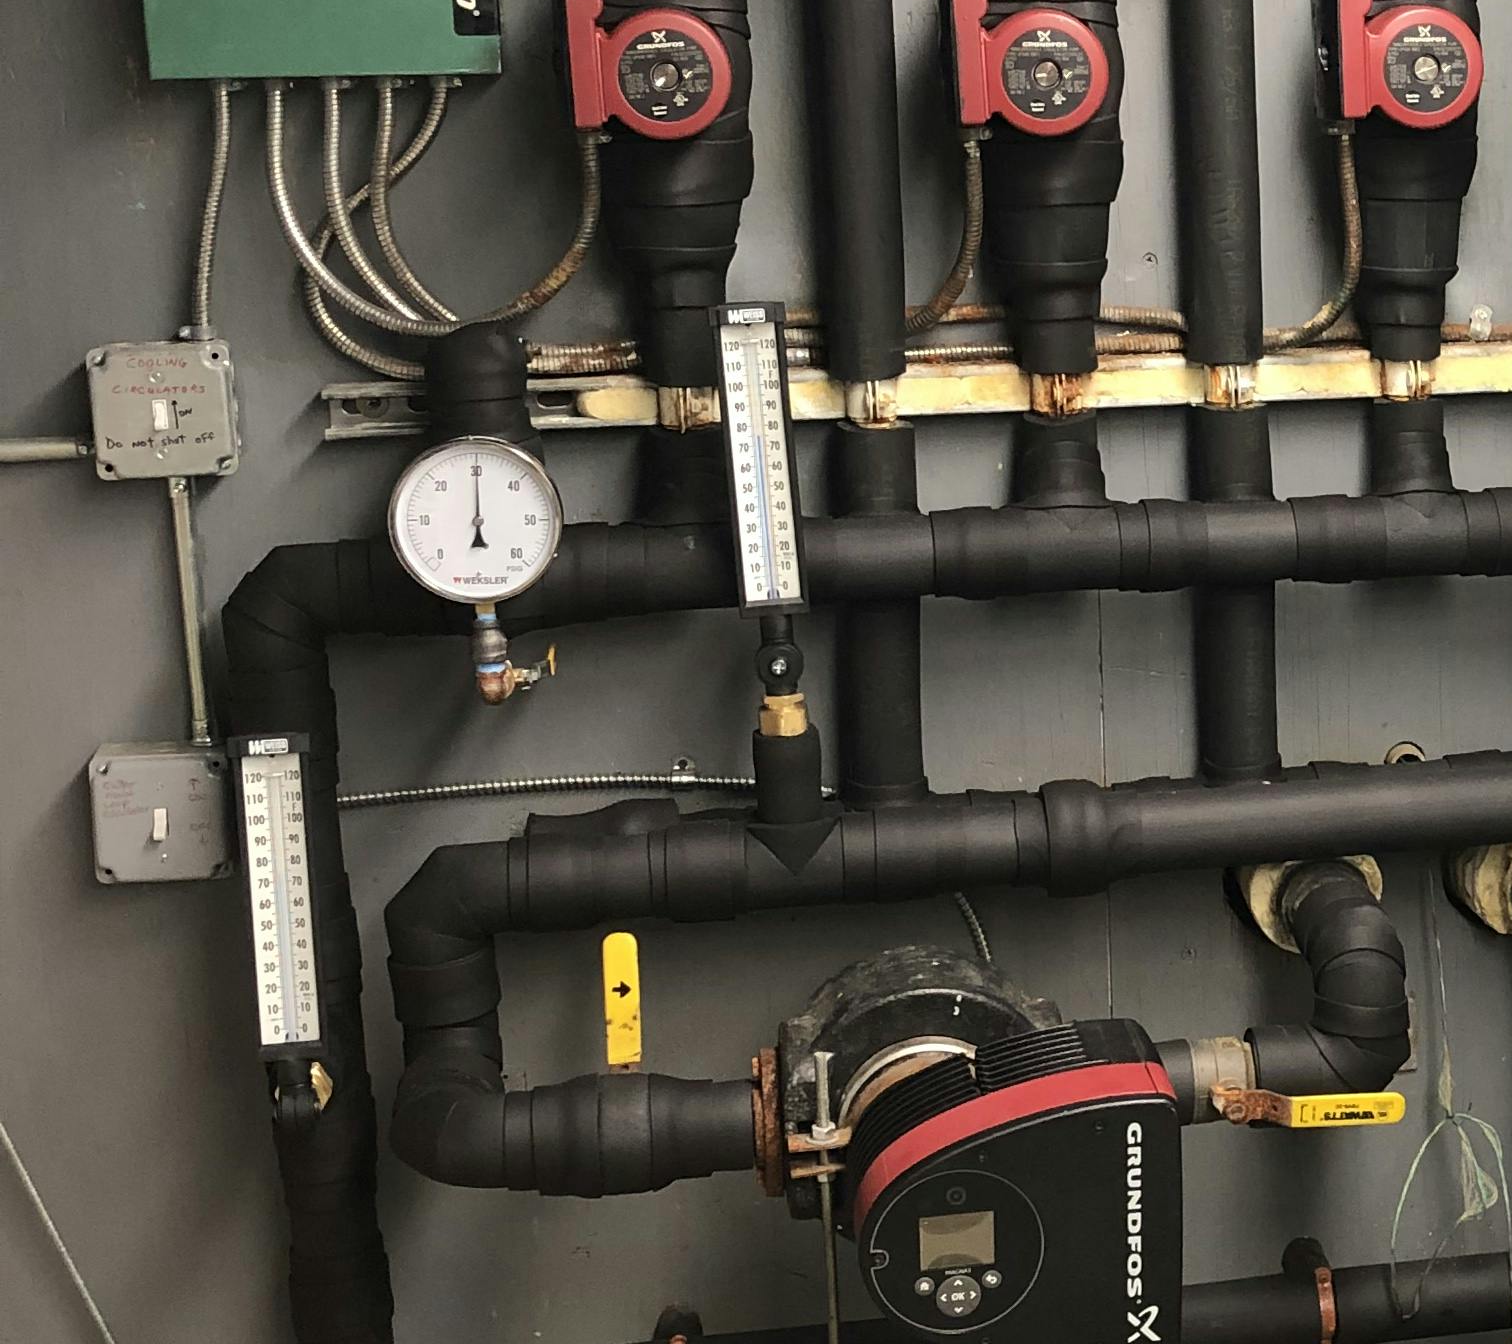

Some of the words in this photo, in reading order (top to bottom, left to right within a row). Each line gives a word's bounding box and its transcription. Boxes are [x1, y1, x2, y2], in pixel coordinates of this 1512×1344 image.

[724, 341, 739, 352] 120
[761, 339, 775, 348] 120
[126, 357, 188, 369] COOLING
[726, 362, 741, 372] 110
[762, 360, 777, 369] 110
[112, 383, 206, 394] CIRCULATORS
[728, 382, 743, 392] 100
[764, 381, 778, 389] 100
[735, 403, 745, 411] 90
[766, 401, 776, 409] 90
[737, 423, 747, 432] 80
[768, 421, 778, 430] 80
[105, 436, 123, 450] Do
[739, 443, 749, 453] 70
[770, 441, 780, 450] 70
[470, 466, 482, 476] 30
[741, 463, 750, 473] 60
[772, 461, 782, 470] 60
[434, 480, 447, 492] 20
[508, 481, 520, 492] 40
[743, 484, 752, 493] 50
[774, 481, 784, 490] 50
[745, 504, 754, 512] 40
[776, 502, 785, 510] 40
[420, 515, 430, 526] 10
[524, 515, 536, 526] 50
[747, 524, 756, 533] 30
[778, 521, 787, 530] 30
[510, 548, 523, 558] 60
[749, 543, 758, 553] 20
[780, 541, 789, 550] 20
[437, 548, 444, 560] 0
[751, 563, 760, 572] 10
[781, 561, 790, 570] 10
[463, 576, 508, 584] WEKSLER
[757, 583, 762, 591] 0
[783, 582, 788, 590] 0
[245, 773, 262, 783] 120
[284, 770, 299, 780] 120
[247, 794, 263, 804] 110
[286, 792, 300, 801] 110
[248, 815, 265, 825] 100
[287, 813, 302, 822] 100
[255, 836, 266, 846] 90
[289, 834, 299, 843] 90
[256, 857, 268, 867] 80
[291, 855, 300, 864] 80
[258, 879, 269, 888] 70
[292, 876, 302, 885] 70
[260, 899, 270, 909] 60
[294, 897, 304, 907] 60
[261, 921, 272, 930] 50
[295, 918, 305, 928] 50
[263, 941, 274, 951] 40
[297, 939, 307, 949] 40
[264, 963, 275, 972] 30
[298, 961, 308, 970] 30
[265, 984, 277, 994] 20
[300, 982, 310, 991] 20
[268, 1005, 278, 1014] 10
[300, 1003, 310, 1011] 10
[274, 1026, 280, 1035] 0
[303, 1023, 307, 1032] 0
[1126, 1122, 1142, 1298] GRUNDFOS
[951, 1291, 965, 1301] OK
